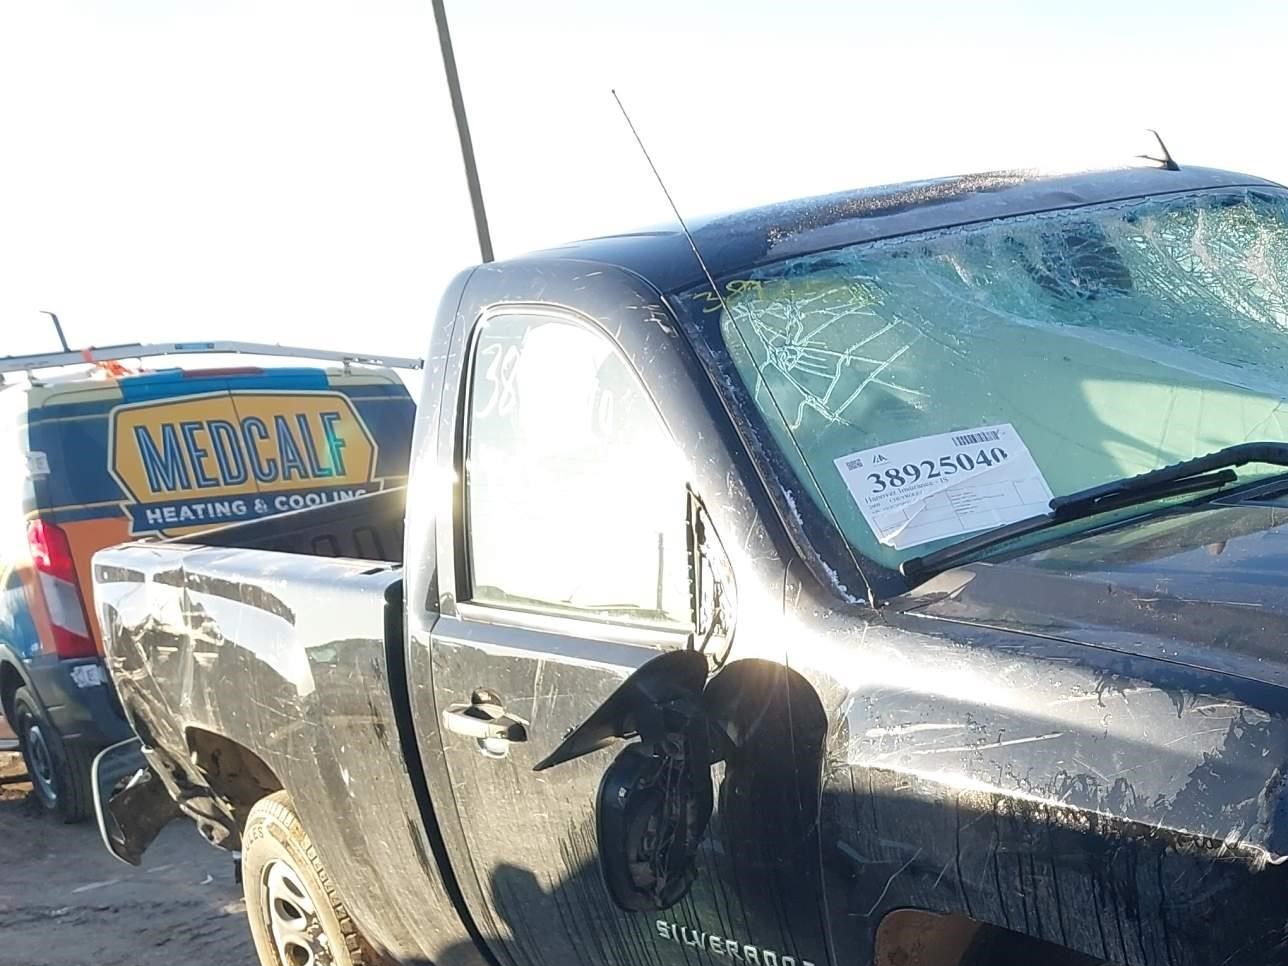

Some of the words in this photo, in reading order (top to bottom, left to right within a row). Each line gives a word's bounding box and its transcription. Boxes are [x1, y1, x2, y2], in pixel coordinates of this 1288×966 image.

[133, 411, 347, 494] MEDCALF
[866, 446, 1008, 493] 38925040
[146, 499, 247, 524] HEATING
[253, 498, 268, 514] &
